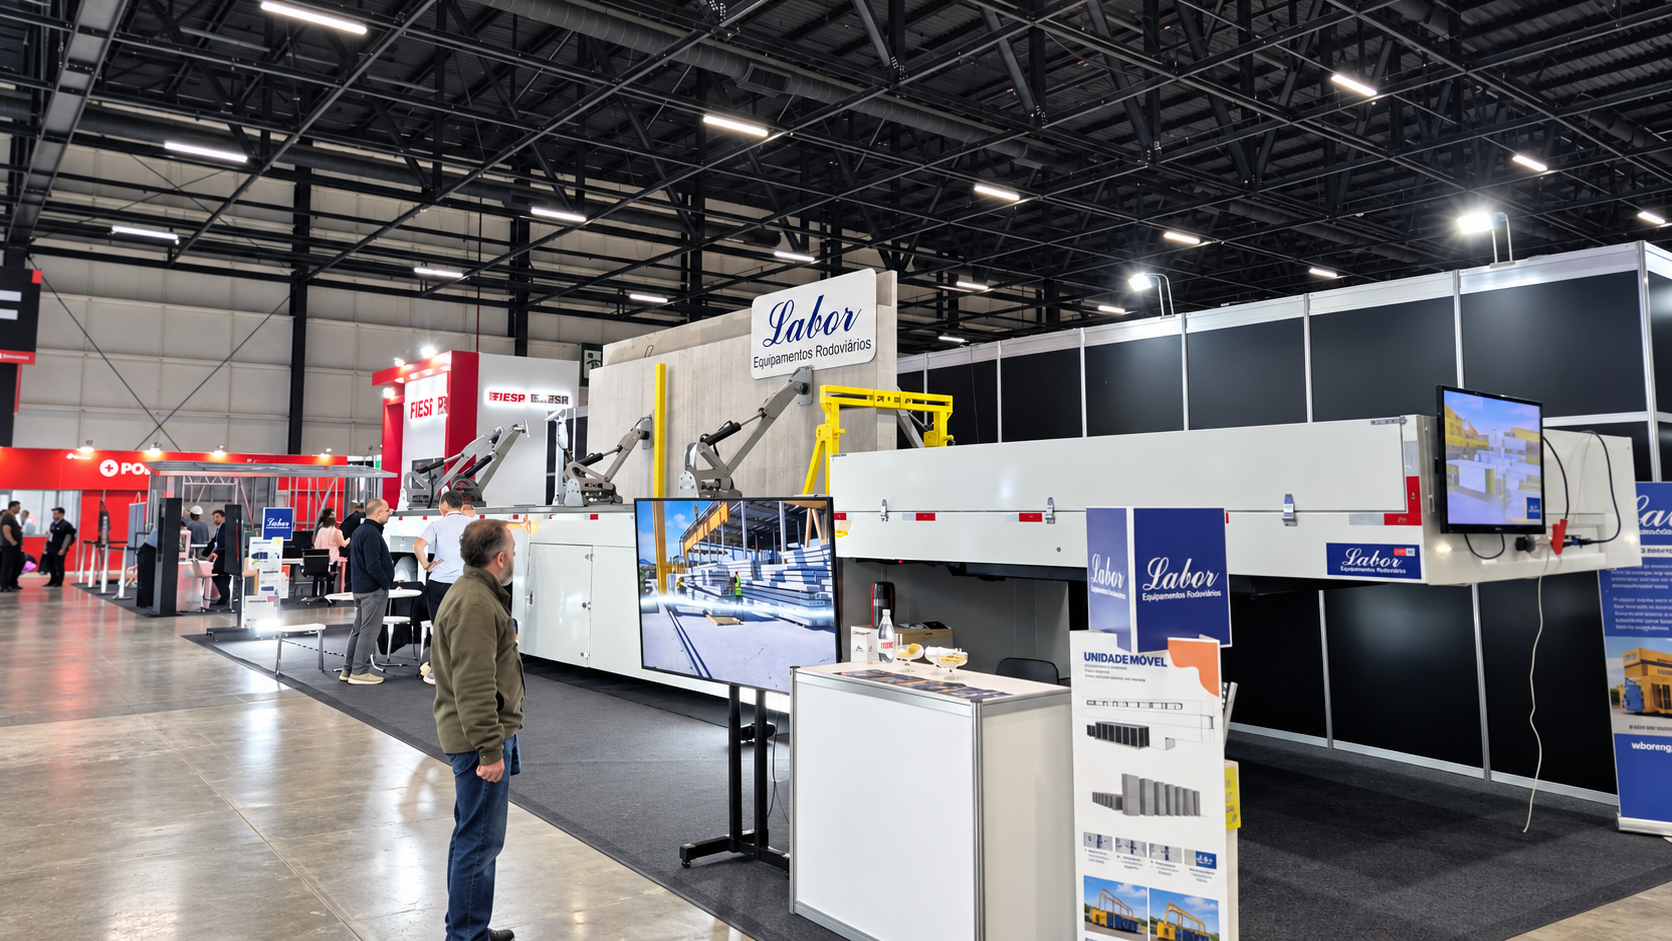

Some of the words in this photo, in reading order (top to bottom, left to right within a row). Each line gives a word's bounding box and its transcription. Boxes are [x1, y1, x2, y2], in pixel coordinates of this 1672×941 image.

[762, 294, 862, 348] Labor
[753, 348, 813, 370] Equipamentos
[815, 337, 872, 358] Rodoviários
[1090, 553, 1125, 589] Labor
[1142, 556, 1220, 591] Labor
[1341, 547, 1403, 568] Labor
[1142, 591, 1186, 602] Equipamentos
[1083, 651, 1129, 665] UNIDADE
